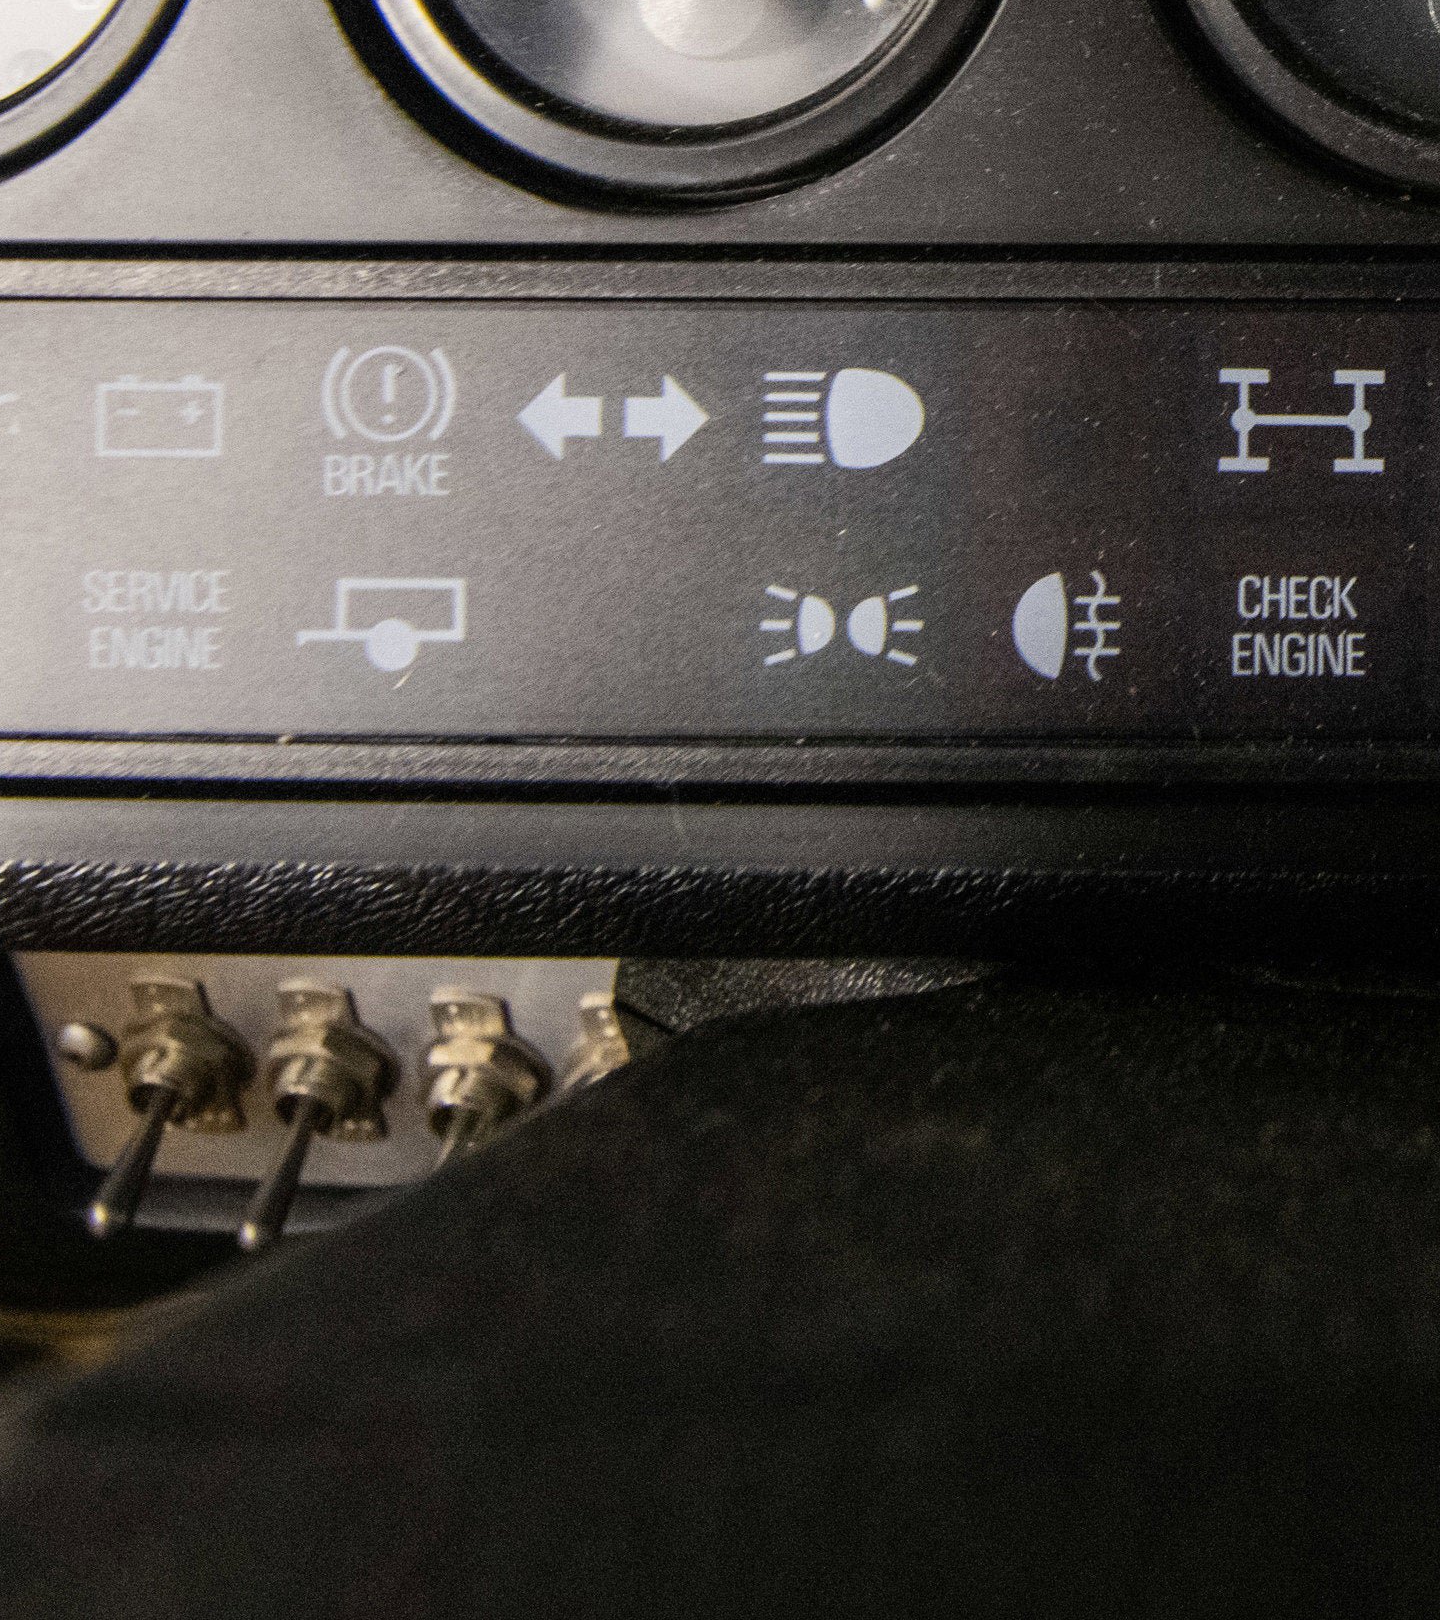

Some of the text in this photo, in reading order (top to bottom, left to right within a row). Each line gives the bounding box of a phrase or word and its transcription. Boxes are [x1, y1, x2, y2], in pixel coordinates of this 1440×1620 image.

[321, 454, 451, 496] BRAKE
[81, 570, 232, 615] SERVICE
[1237, 576, 1357, 620] CHECK
[90, 627, 224, 670] ENGINE
[1232, 633, 1366, 678] ENGINE
